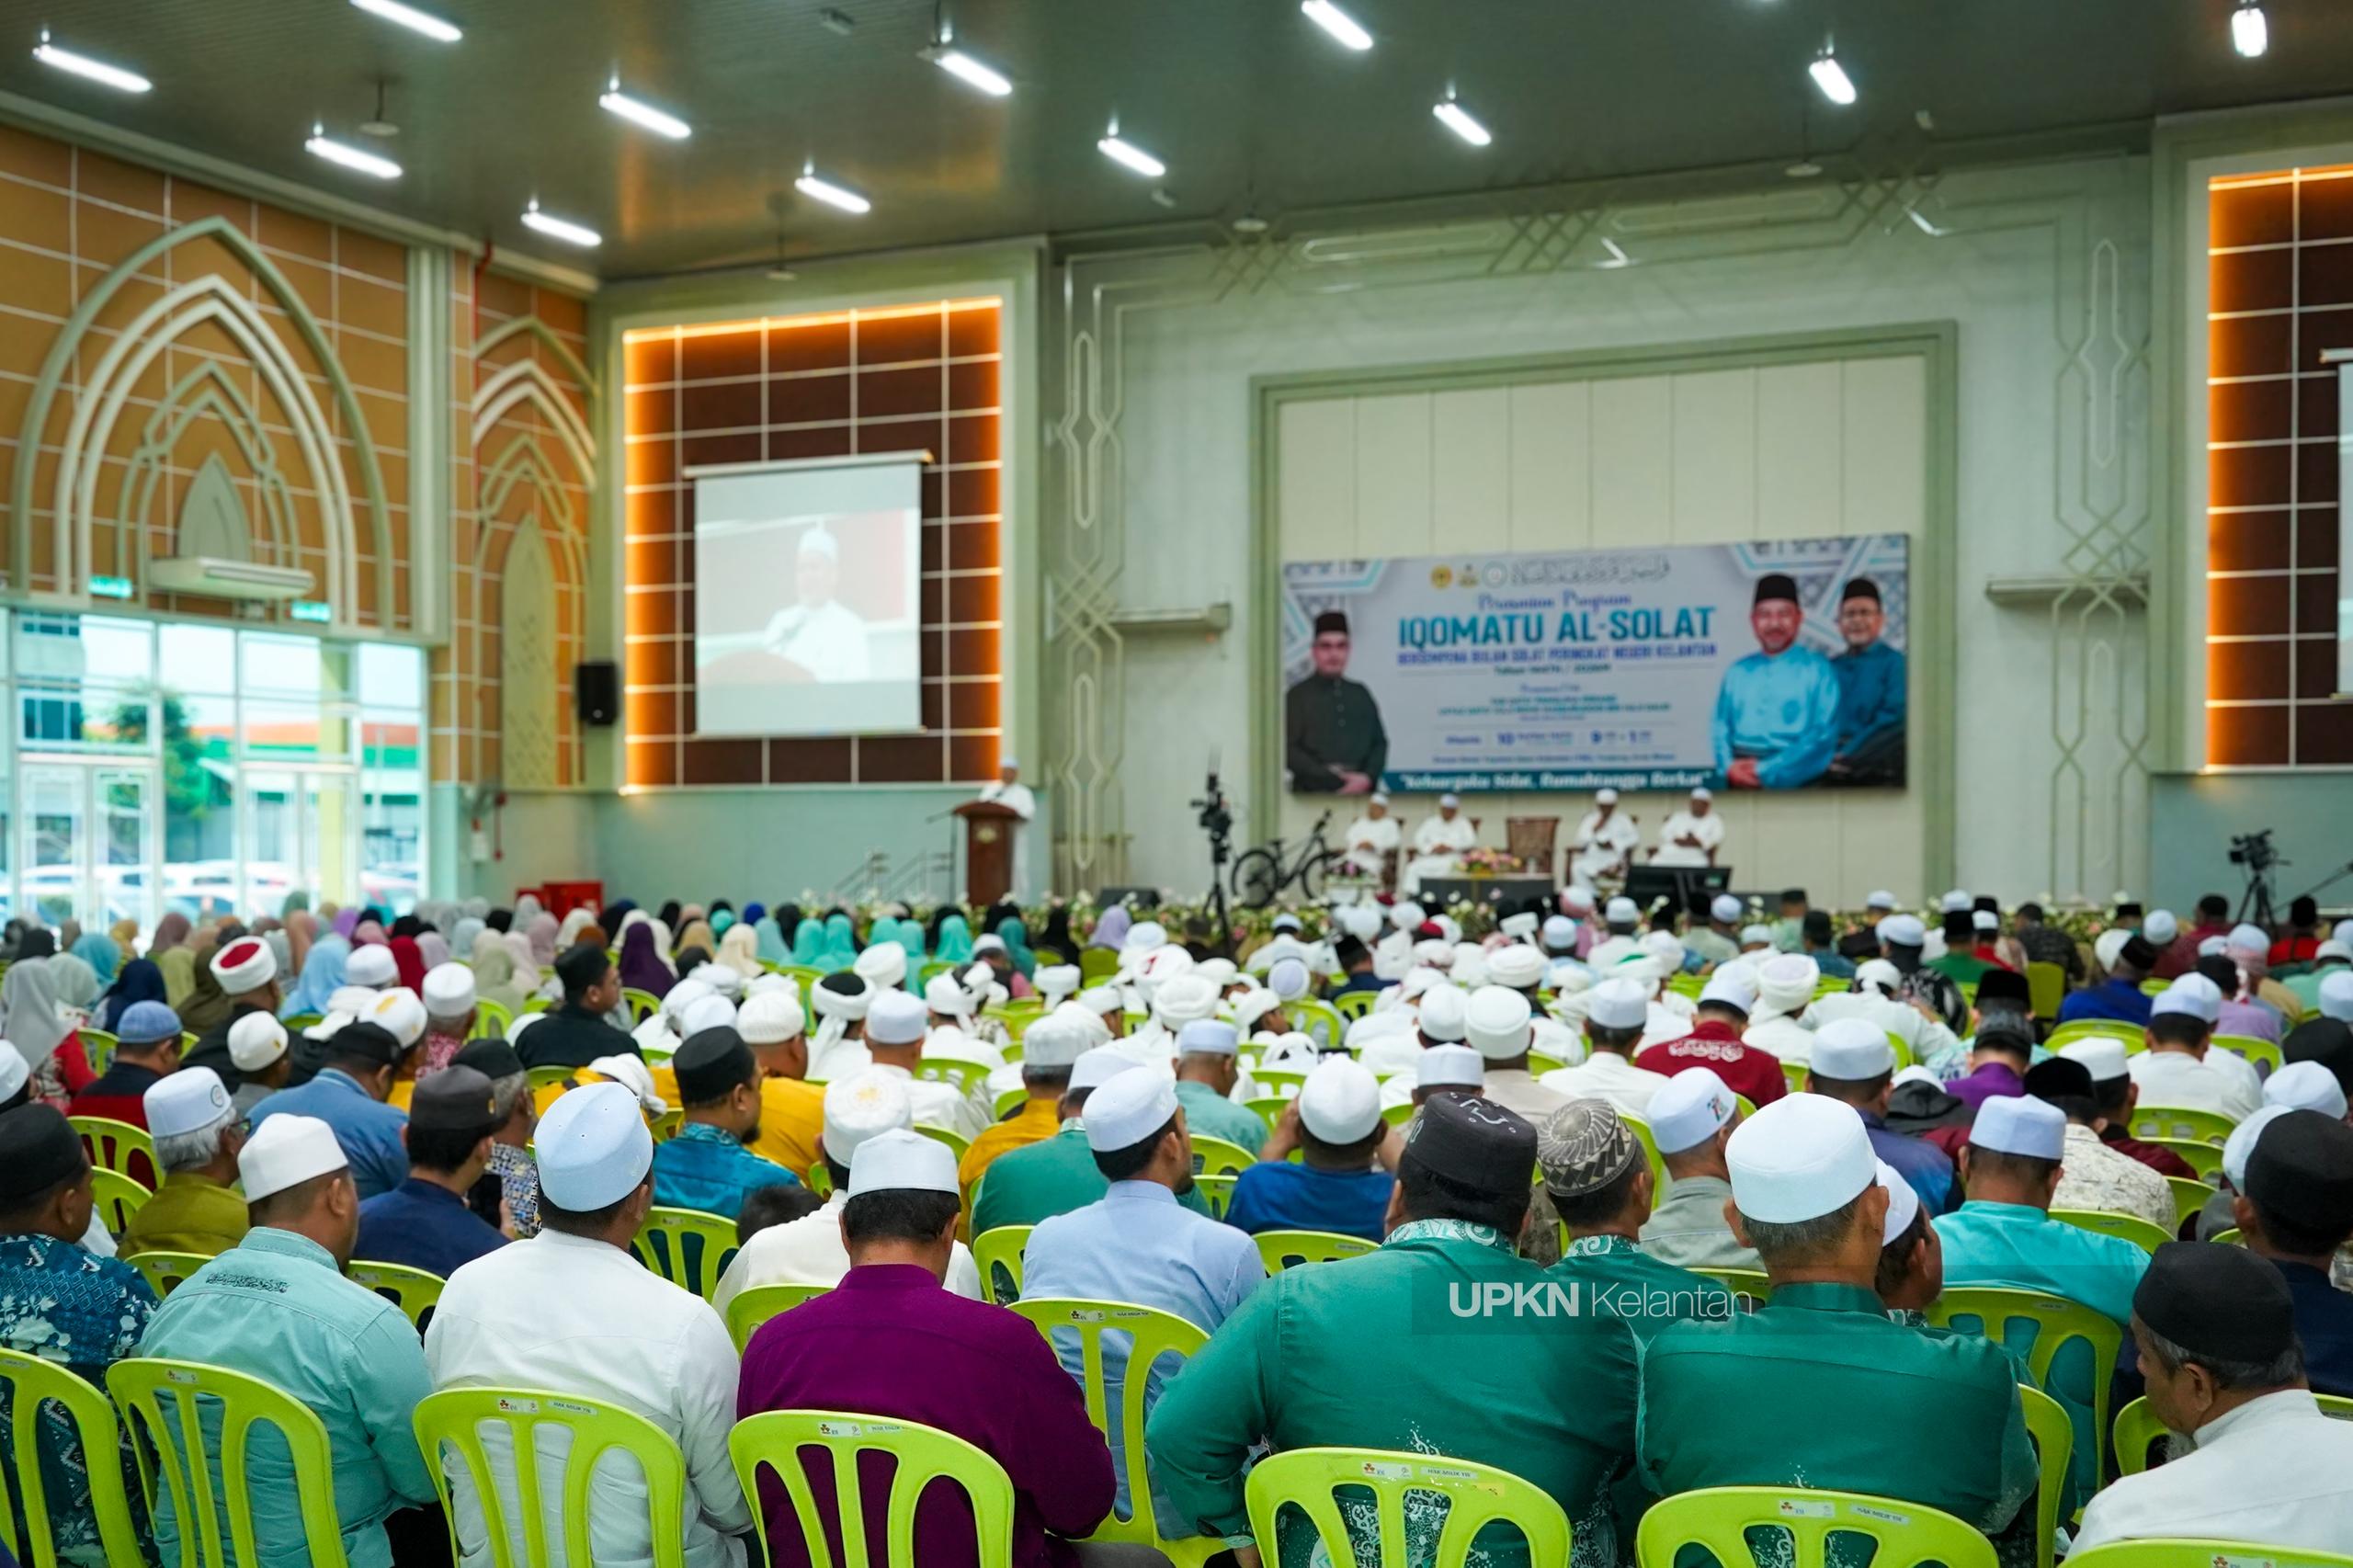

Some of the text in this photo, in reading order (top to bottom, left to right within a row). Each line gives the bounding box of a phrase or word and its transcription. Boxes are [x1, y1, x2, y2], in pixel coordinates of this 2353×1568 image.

[1398, 607, 1717, 653] IQOMATU AL-SOLAT
[1656, 643, 1717, 658] KELANTAN
